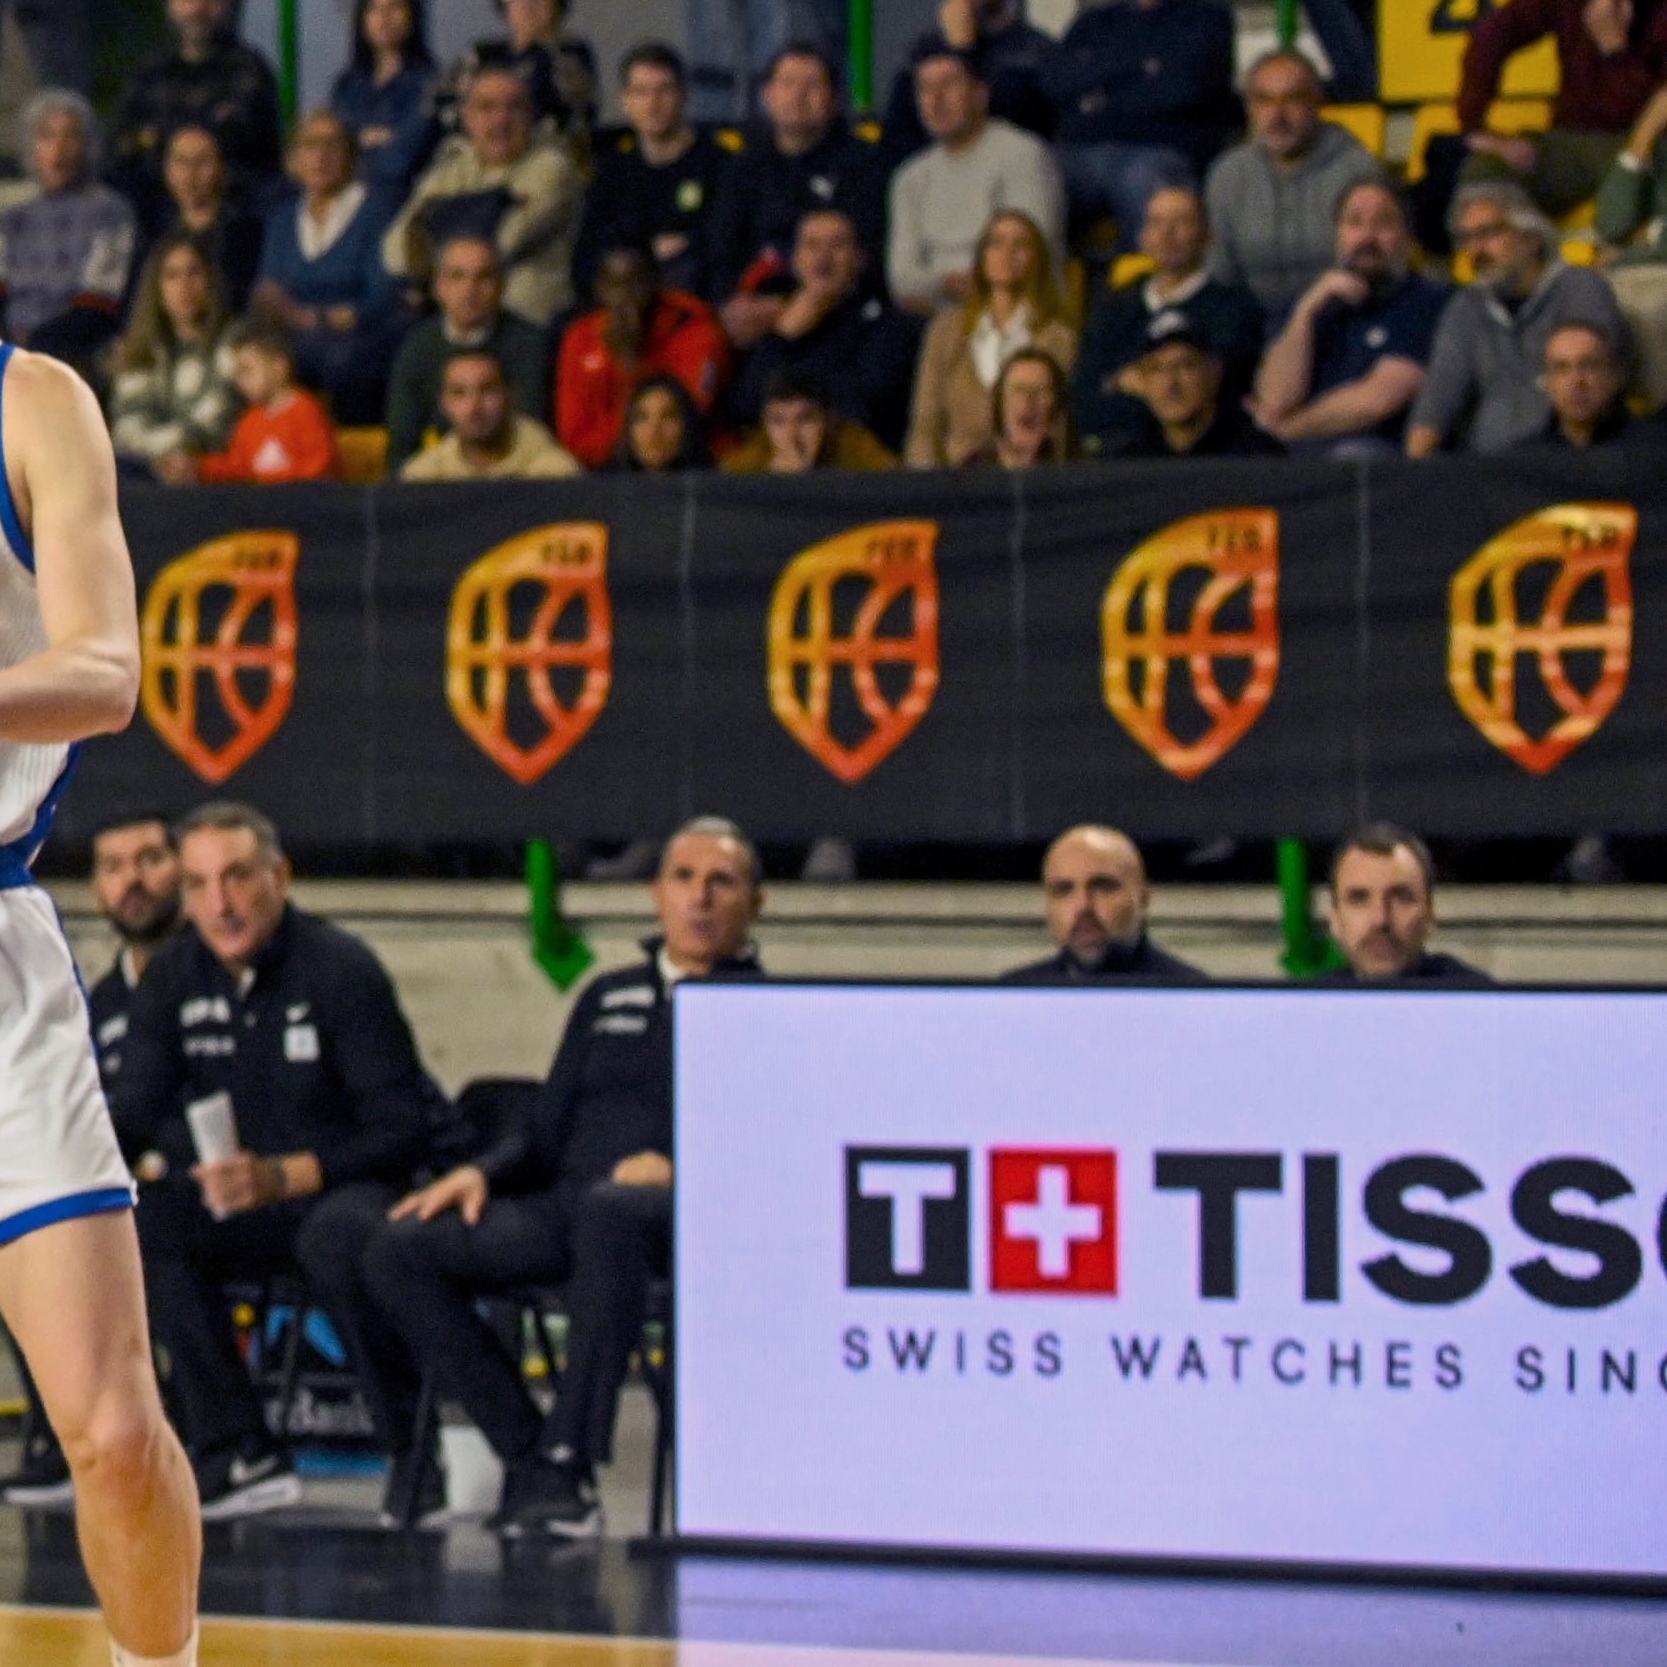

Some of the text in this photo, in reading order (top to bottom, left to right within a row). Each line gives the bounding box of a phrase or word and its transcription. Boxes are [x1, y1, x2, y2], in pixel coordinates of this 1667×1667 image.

[1154, 1152, 1667, 1310] TISS
[842, 1327, 1667, 1394] SWISS WATCHES SIN
